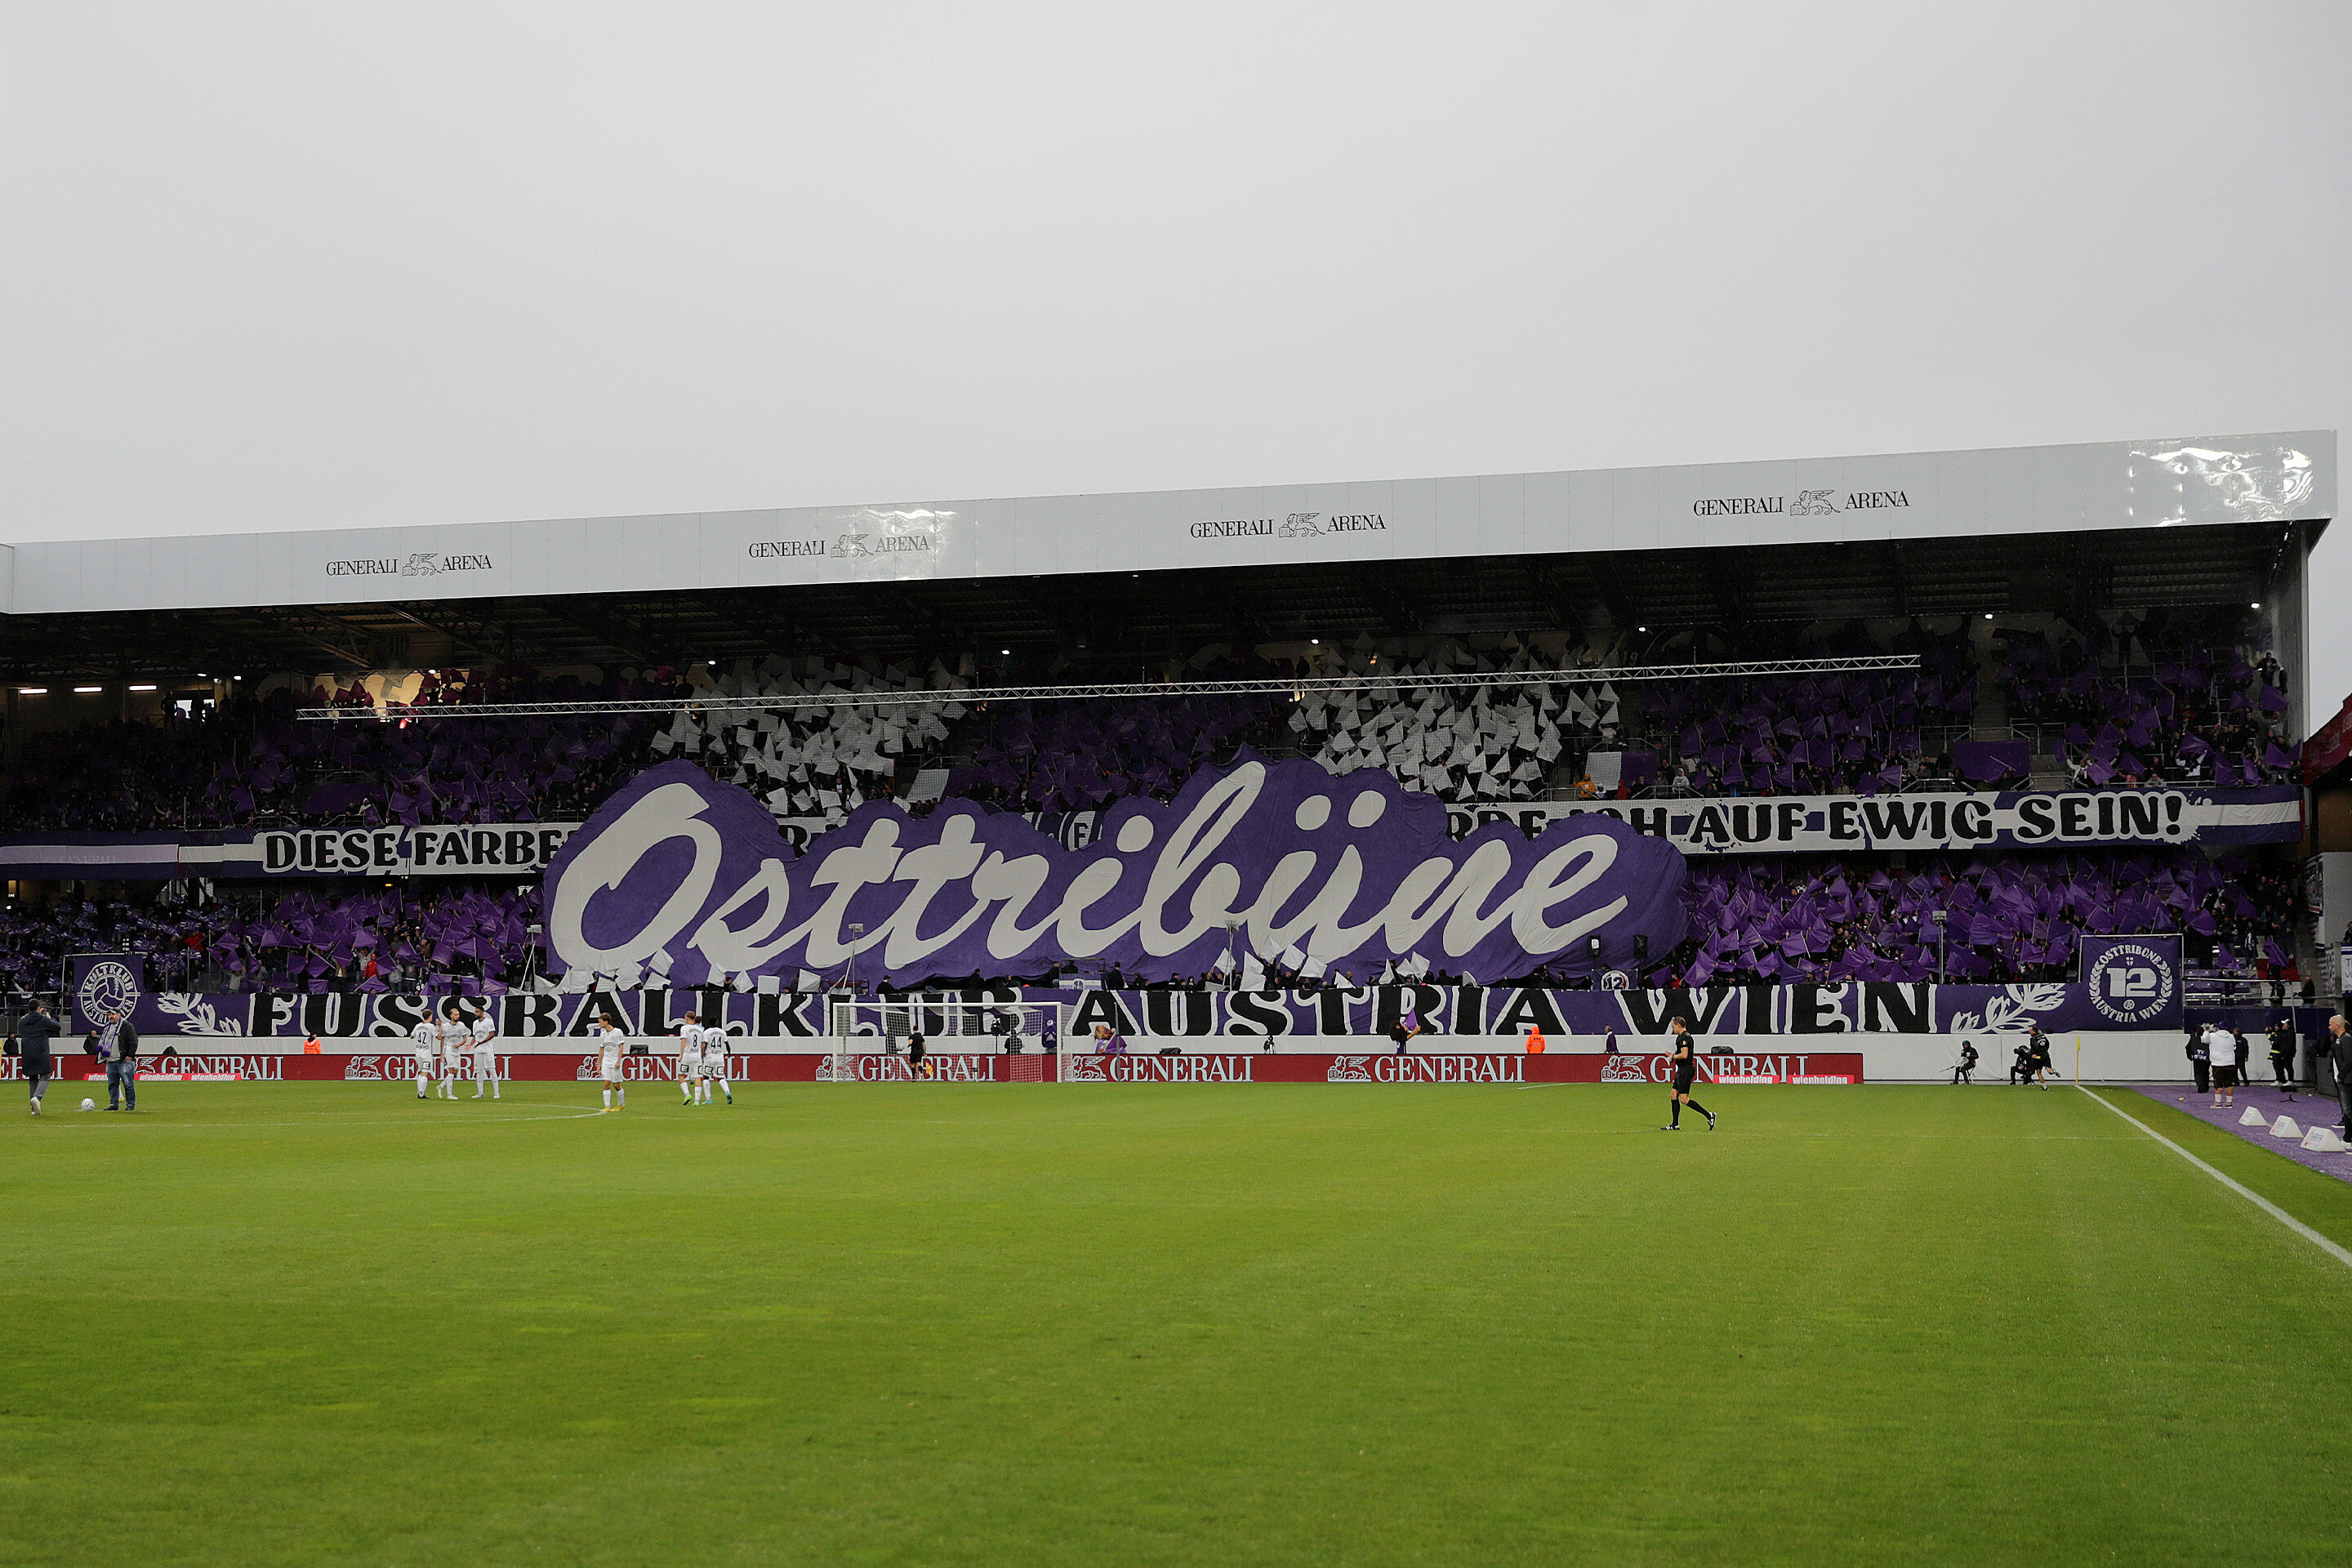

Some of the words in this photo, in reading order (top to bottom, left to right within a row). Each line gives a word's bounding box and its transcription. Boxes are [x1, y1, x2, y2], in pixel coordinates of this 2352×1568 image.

[1693, 497, 1784, 516] GENERALI
[1844, 490, 1910, 510] ARENA
[1190, 519, 1274, 538] GENERALI
[1327, 514, 1387, 532] ARENA
[749, 540, 826, 558] GENERALI
[875, 536, 930, 553] ARENA
[326, 559, 399, 576] GENERALI
[442, 555, 493, 571] ARENA
[265, 830, 399, 870] DIESE
[414, 829, 579, 866] FARBE
[1689, 802, 1805, 844] AUF
[1828, 800, 1993, 840] EWIG
[2017, 795, 2183, 839] SEIN!
[550, 760, 1628, 972] Osttribüne
[83, 964, 135, 991] KULTKLUB
[1604, 977, 1624, 990] 12
[2106, 967, 2158, 997] 12
[82, 1000, 109, 1023] AUSTRI
[1065, 984, 1573, 1037] AUSTRIA
[1614, 980, 1937, 1035] WIEN
[2090, 995, 2138, 1022] AUSTRIA
[2138, 995, 2168, 1020] WIEN
[417, 1031, 427, 1045] 42
[693, 1034, 697, 1048] 8
[710, 1036, 722, 1049] 44
[161, 1056, 283, 1080] GENERALI
[621, 1055, 750, 1081] GENLI
[858, 1055, 996, 1081] GENERALI
[1109, 1056, 1254, 1082] GENERALI
[1374, 1055, 1526, 1082] GENERALI
[1650, 1055, 1809, 1083] GNERALI
[1718, 1076, 1773, 1084] wienholding
[1793, 1076, 1848, 1085] wienholding
